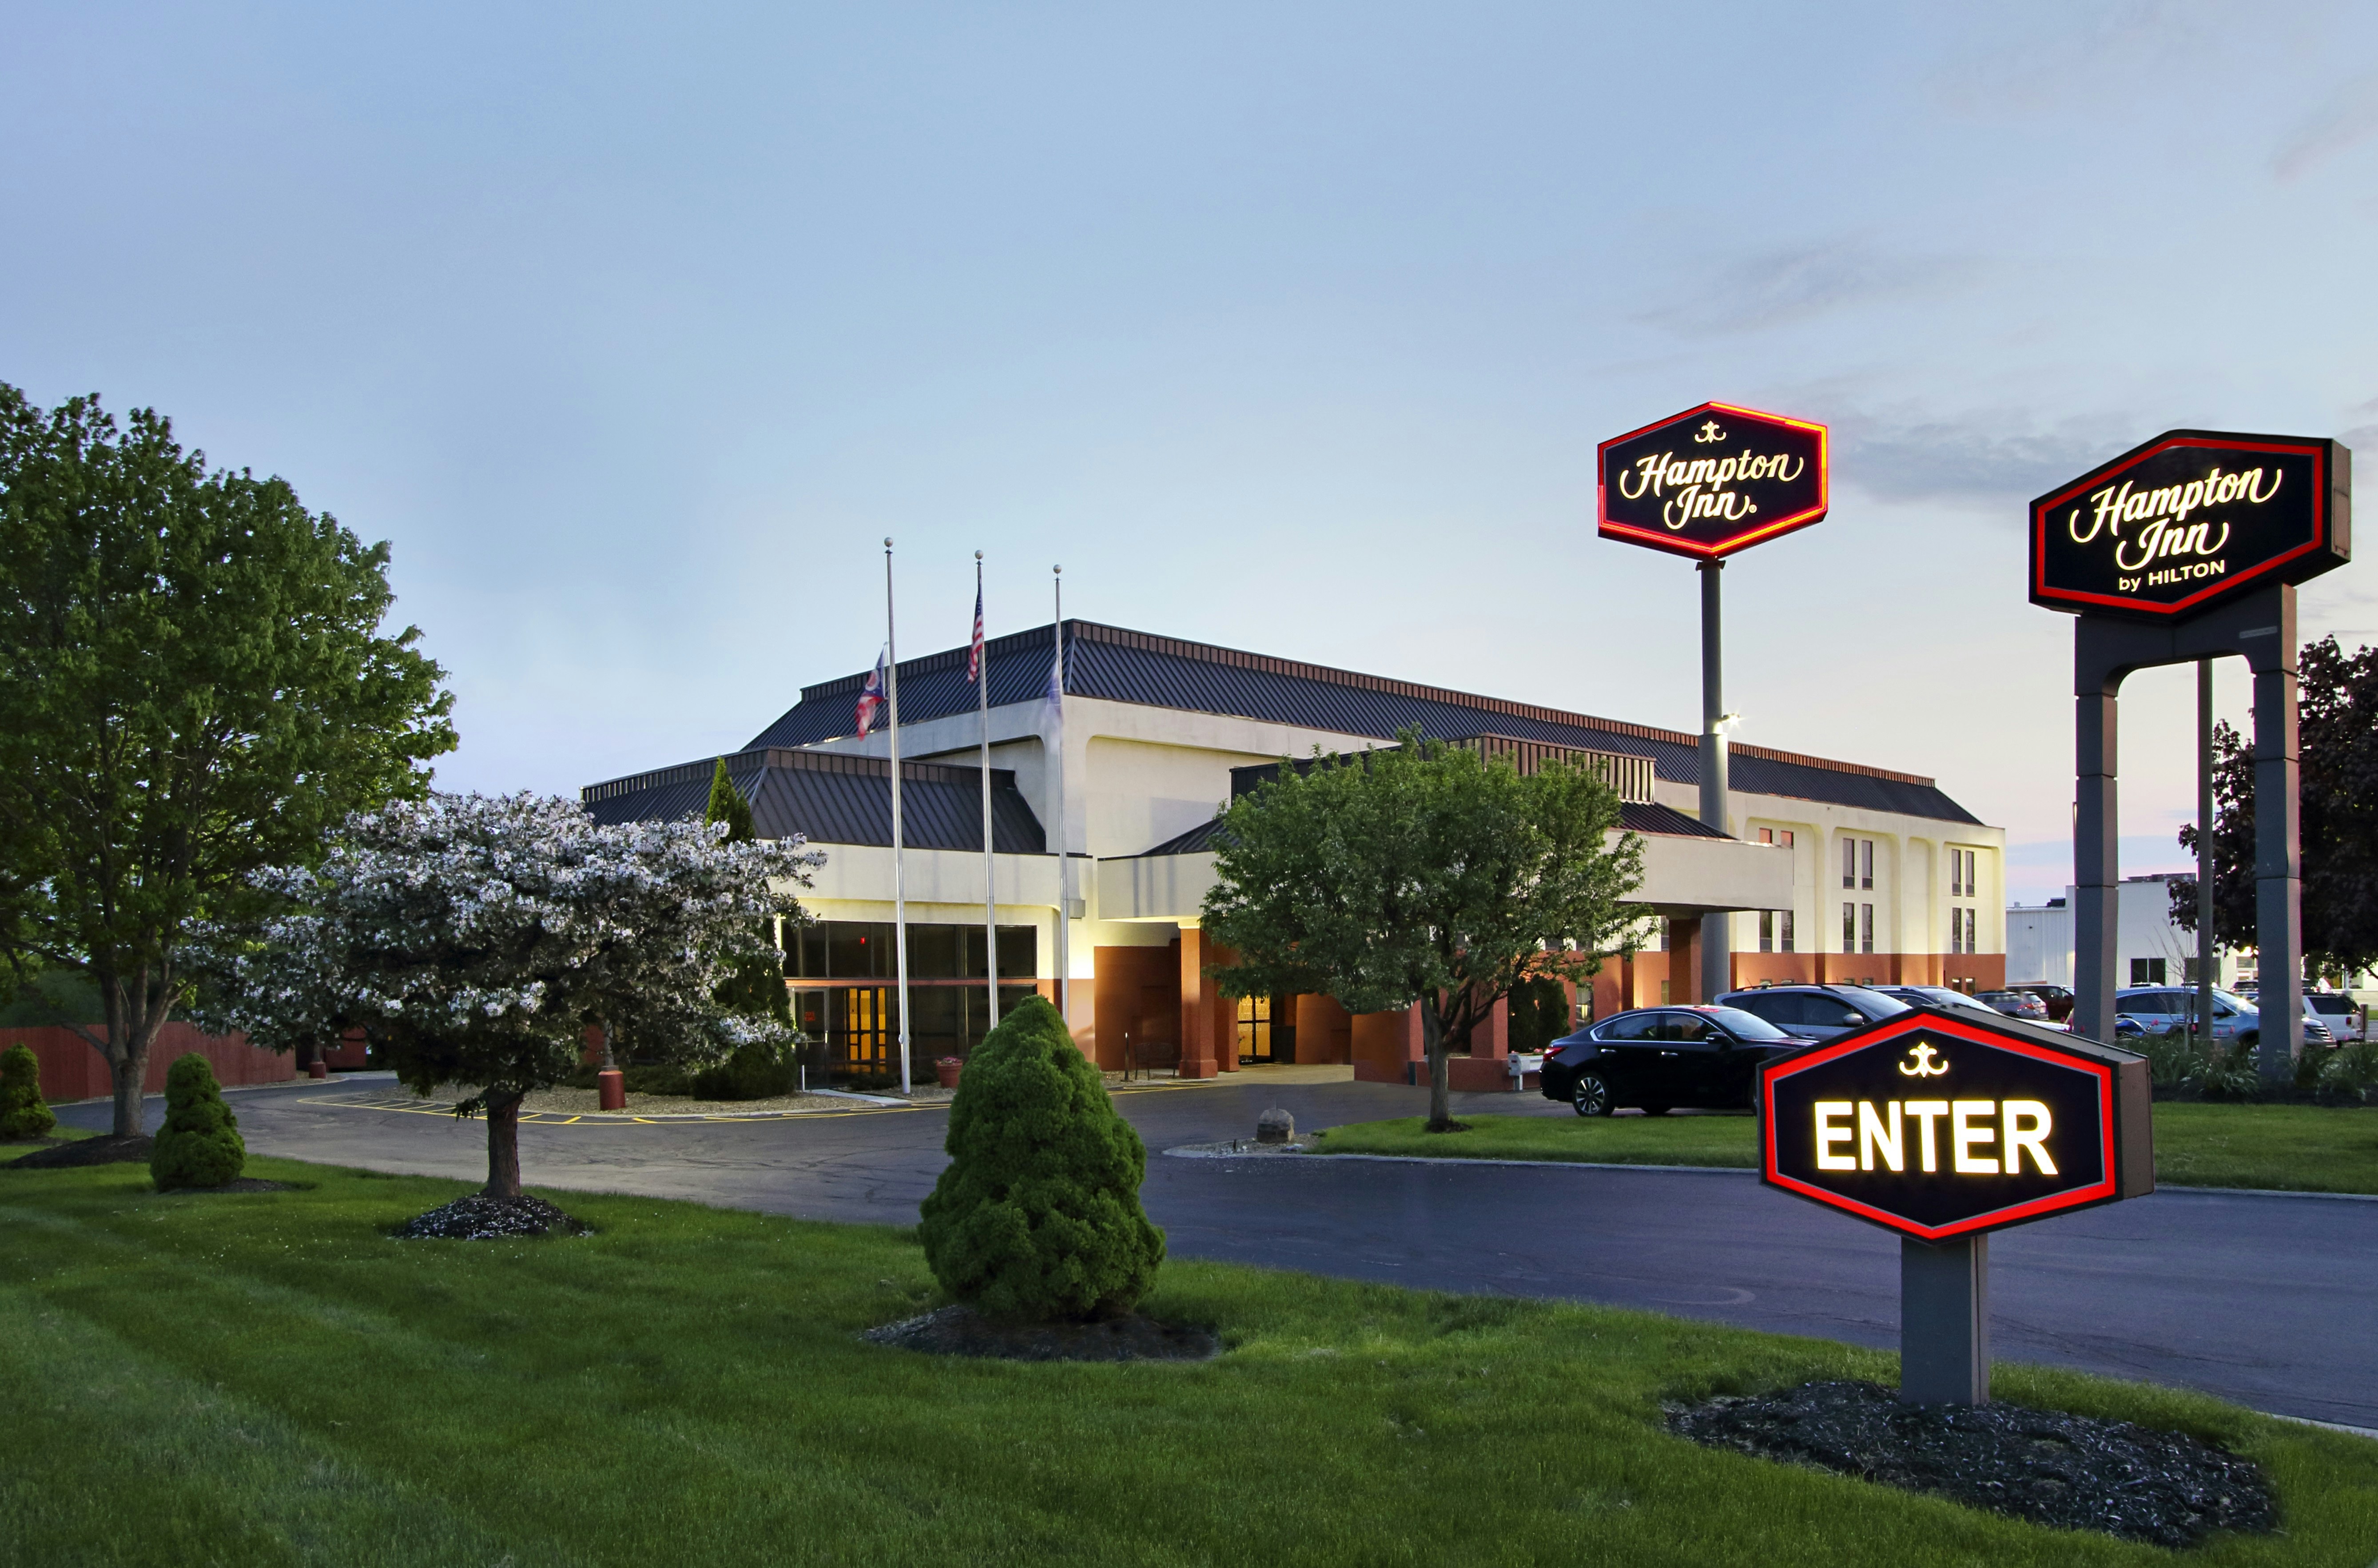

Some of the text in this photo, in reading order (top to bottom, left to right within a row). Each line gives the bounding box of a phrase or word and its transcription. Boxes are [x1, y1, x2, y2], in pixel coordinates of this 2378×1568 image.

[1619, 449, 1804, 499] Hampton
[2069, 468, 2282, 543] Hampton
[2116, 517, 2229, 571] Inn
[2119, 560, 2225, 592] by HILTON
[1814, 1099, 2059, 1175] ENTER
